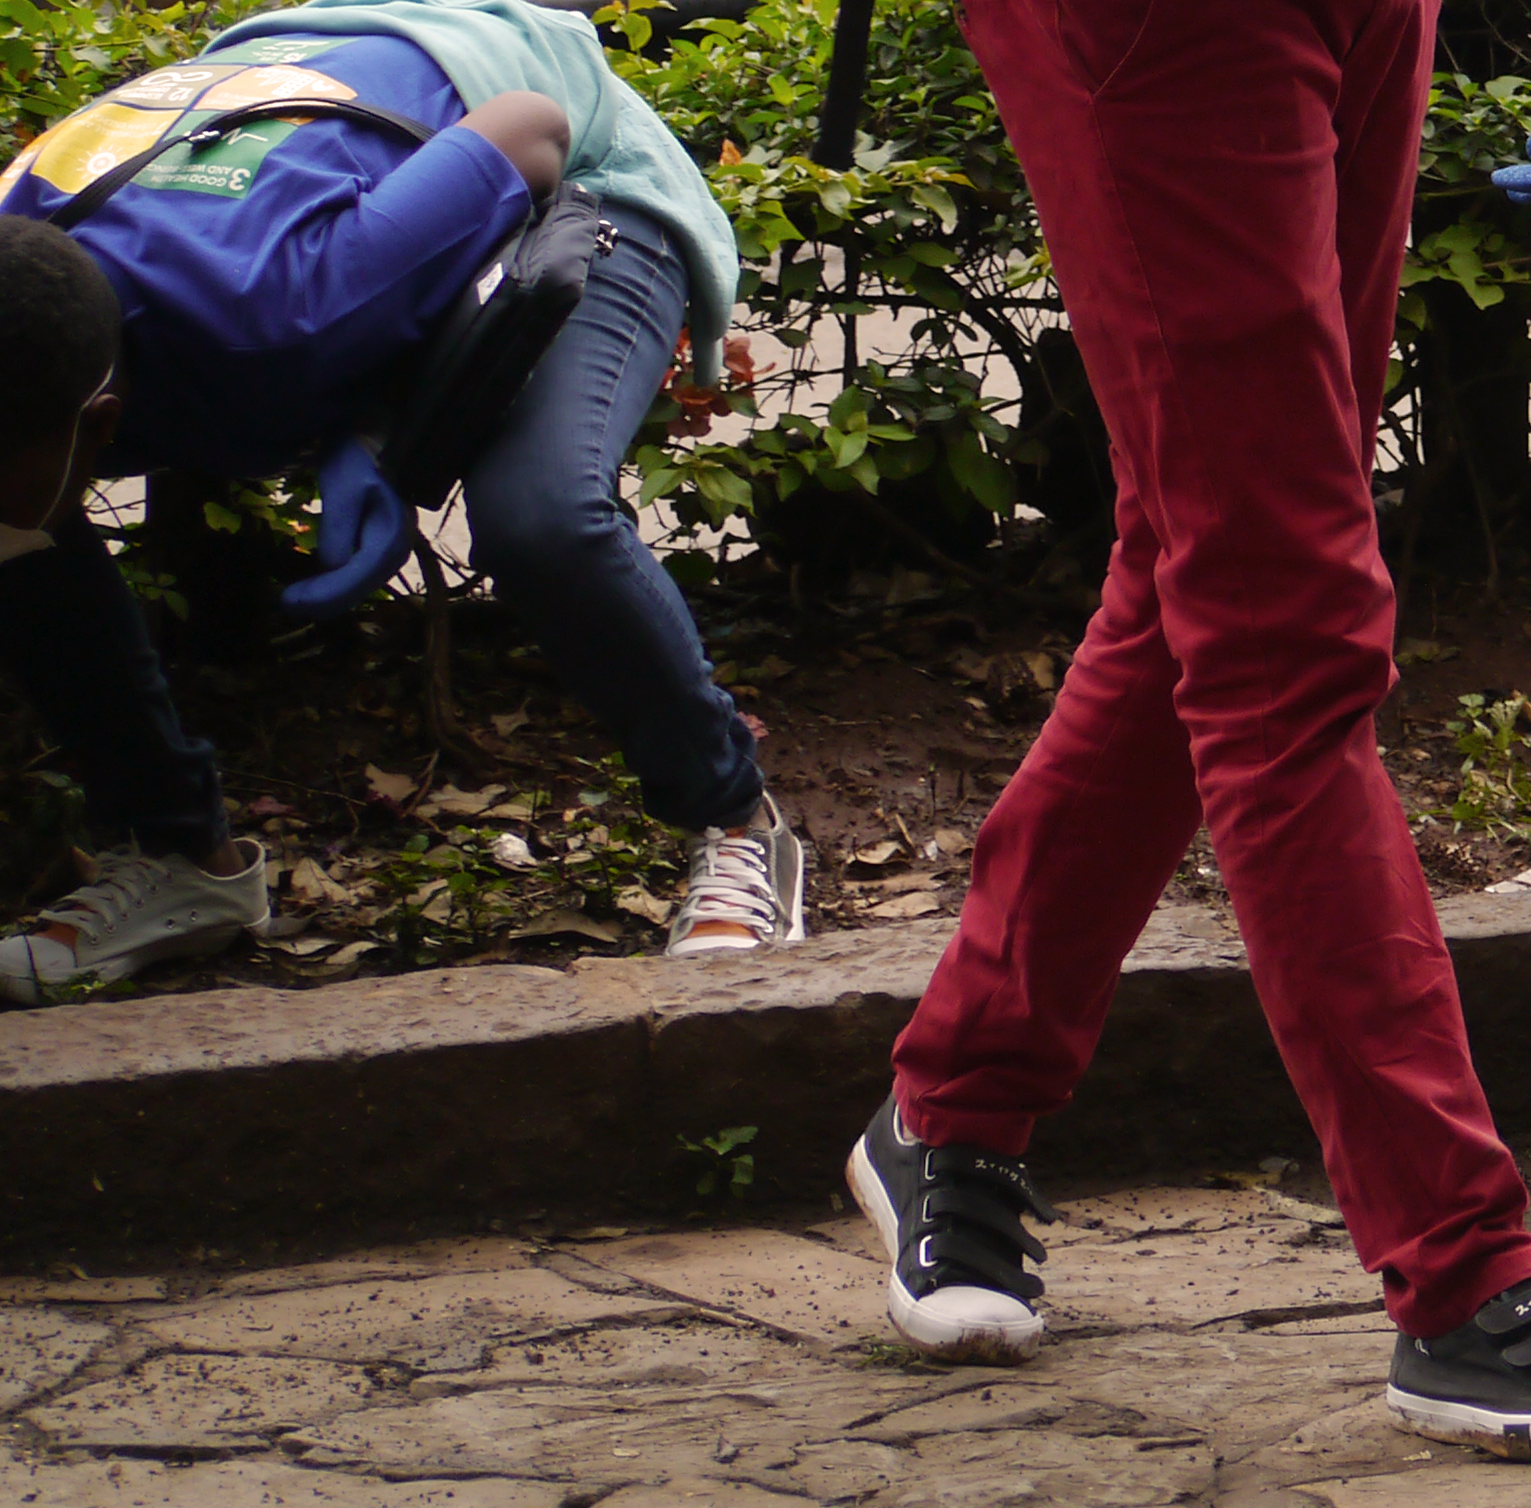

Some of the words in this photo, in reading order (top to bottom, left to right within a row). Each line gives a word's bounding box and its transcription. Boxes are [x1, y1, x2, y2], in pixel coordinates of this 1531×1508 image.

[205, 165, 234, 176] AND
[189, 173, 228, 188] GOOD
[228, 168, 251, 192] 3
